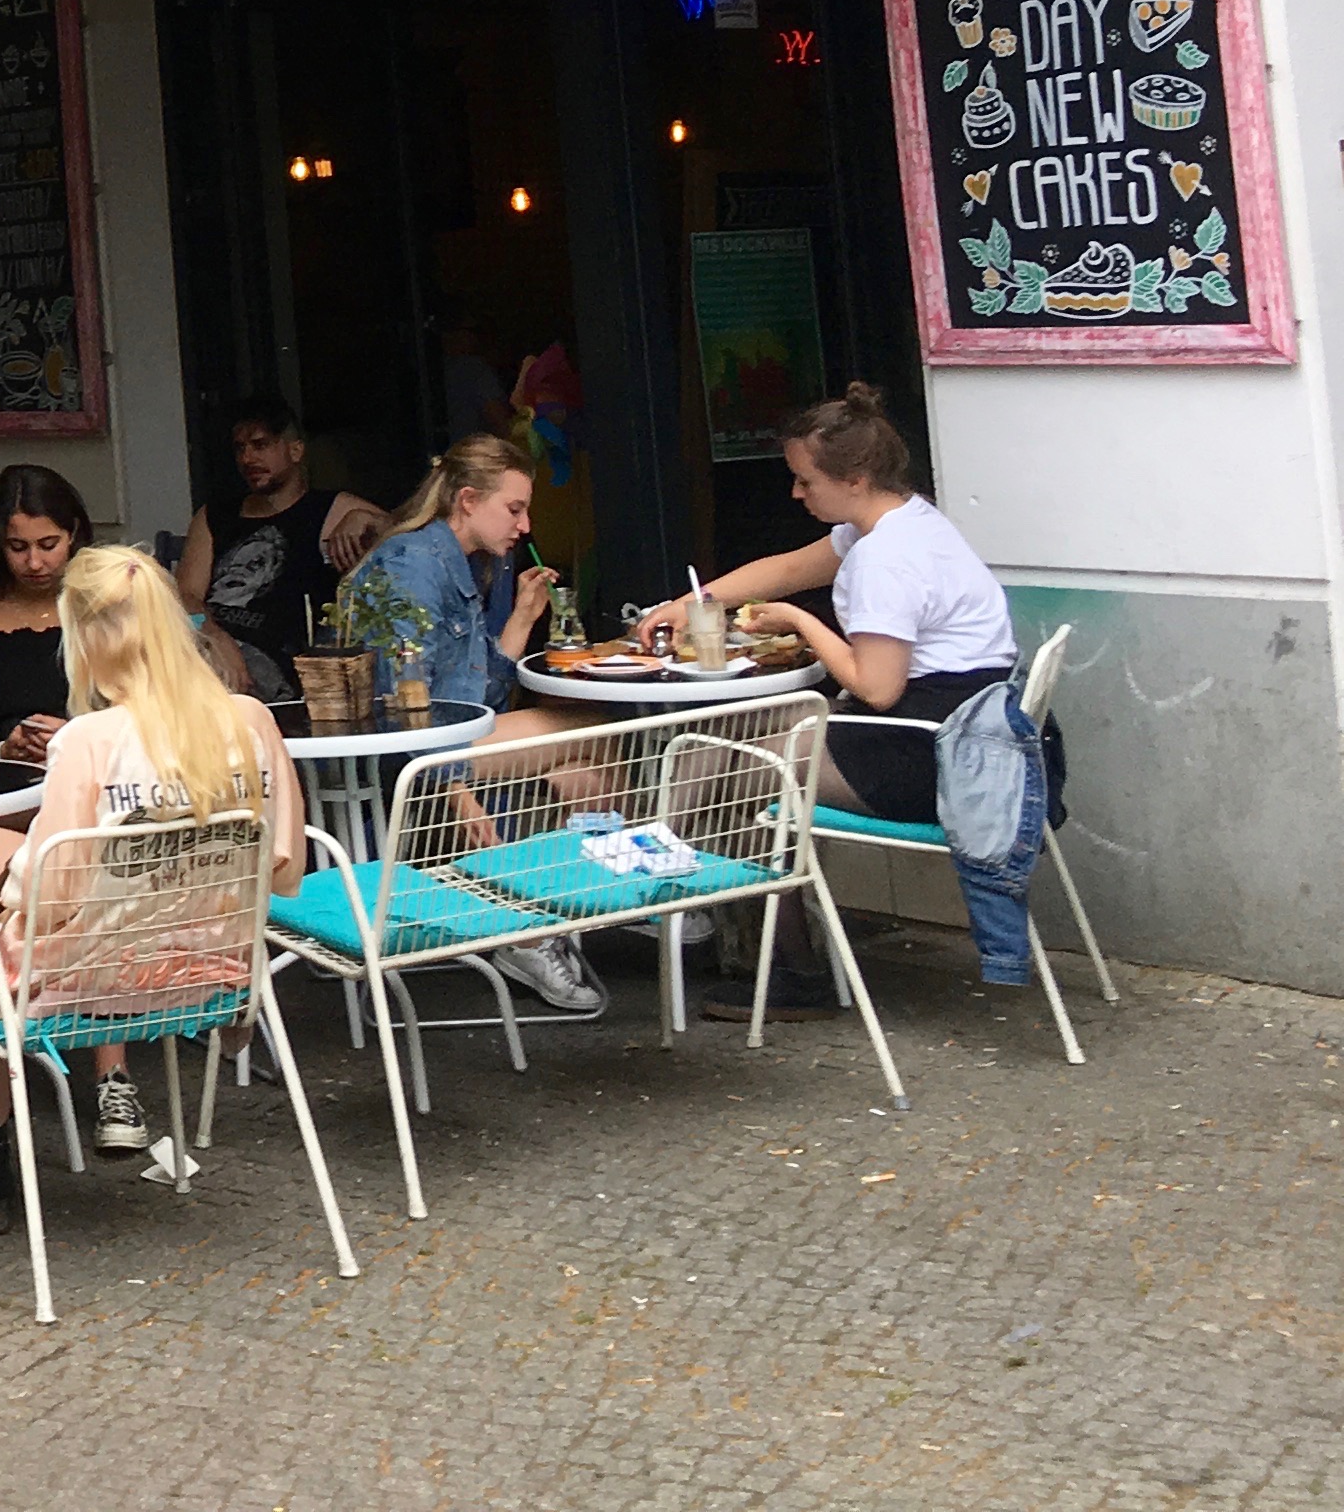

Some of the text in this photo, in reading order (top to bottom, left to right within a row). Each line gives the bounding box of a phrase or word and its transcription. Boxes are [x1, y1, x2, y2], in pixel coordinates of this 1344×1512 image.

[1026, 68, 1125, 148] NEW
[1008, 148, 1158, 230] CAKES
[104, 783, 142, 813] THE
